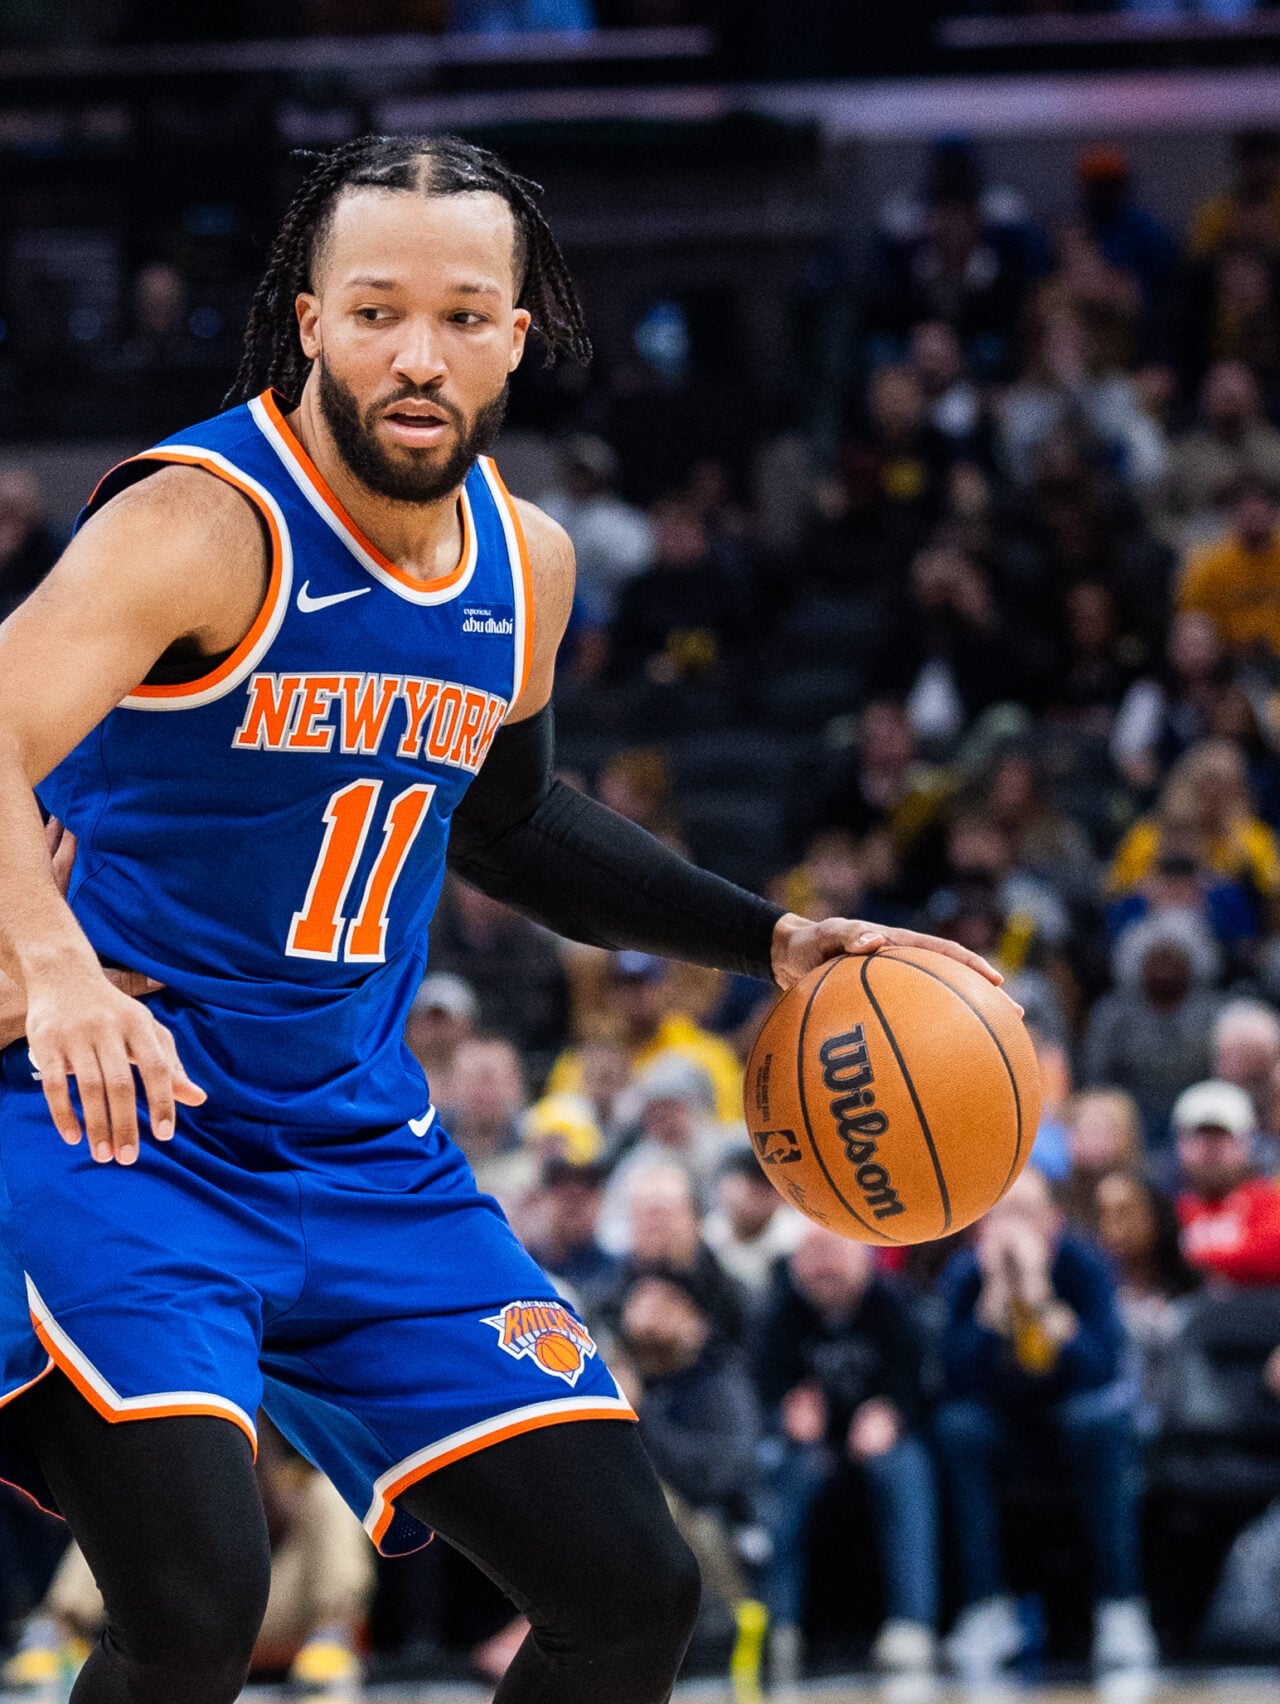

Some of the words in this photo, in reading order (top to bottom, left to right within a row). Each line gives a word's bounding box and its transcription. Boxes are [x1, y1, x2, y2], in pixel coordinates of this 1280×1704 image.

[462, 616, 484, 633] abu
[484, 617, 513, 635] dhabi
[231, 672, 403, 756] NEW
[396, 675, 509, 776] YORK
[285, 778, 436, 963] 11
[818, 1022, 906, 1220] Wilson
